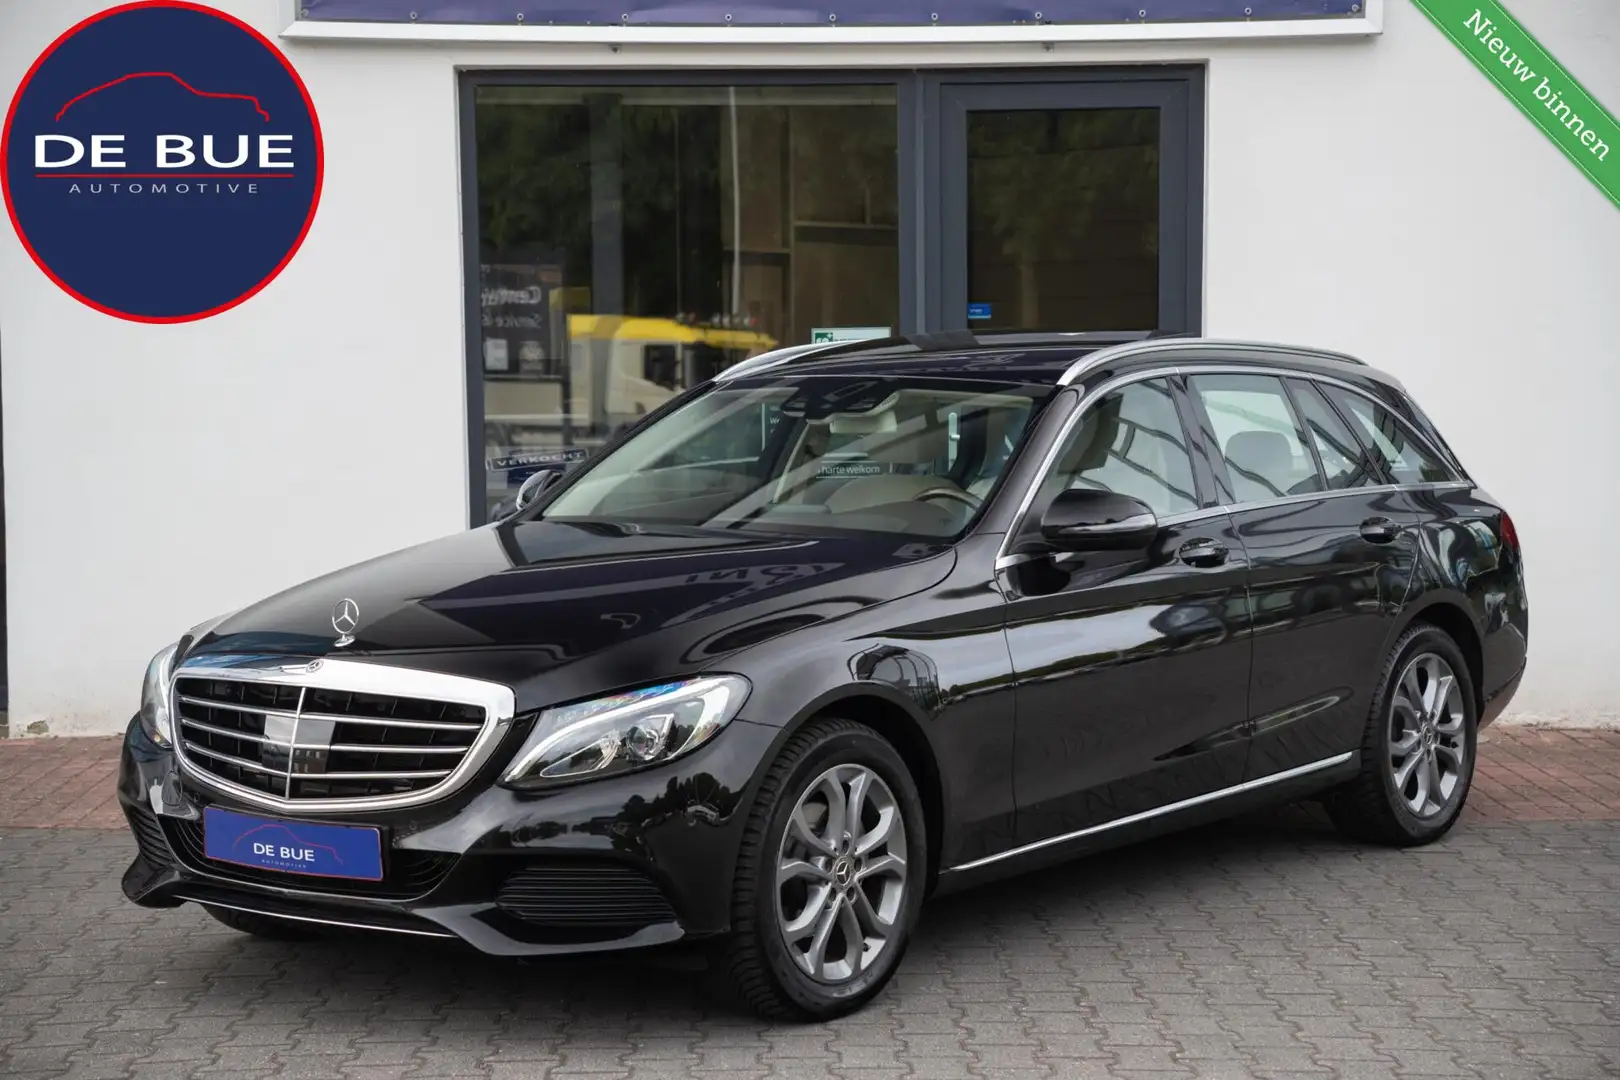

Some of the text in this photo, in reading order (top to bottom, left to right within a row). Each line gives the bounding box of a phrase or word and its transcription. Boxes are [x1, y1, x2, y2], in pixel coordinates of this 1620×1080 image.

[497, 451, 583, 466] VERKOCHT
[846, 464, 880, 474] welkom
[253, 842, 315, 862] DE BUE
